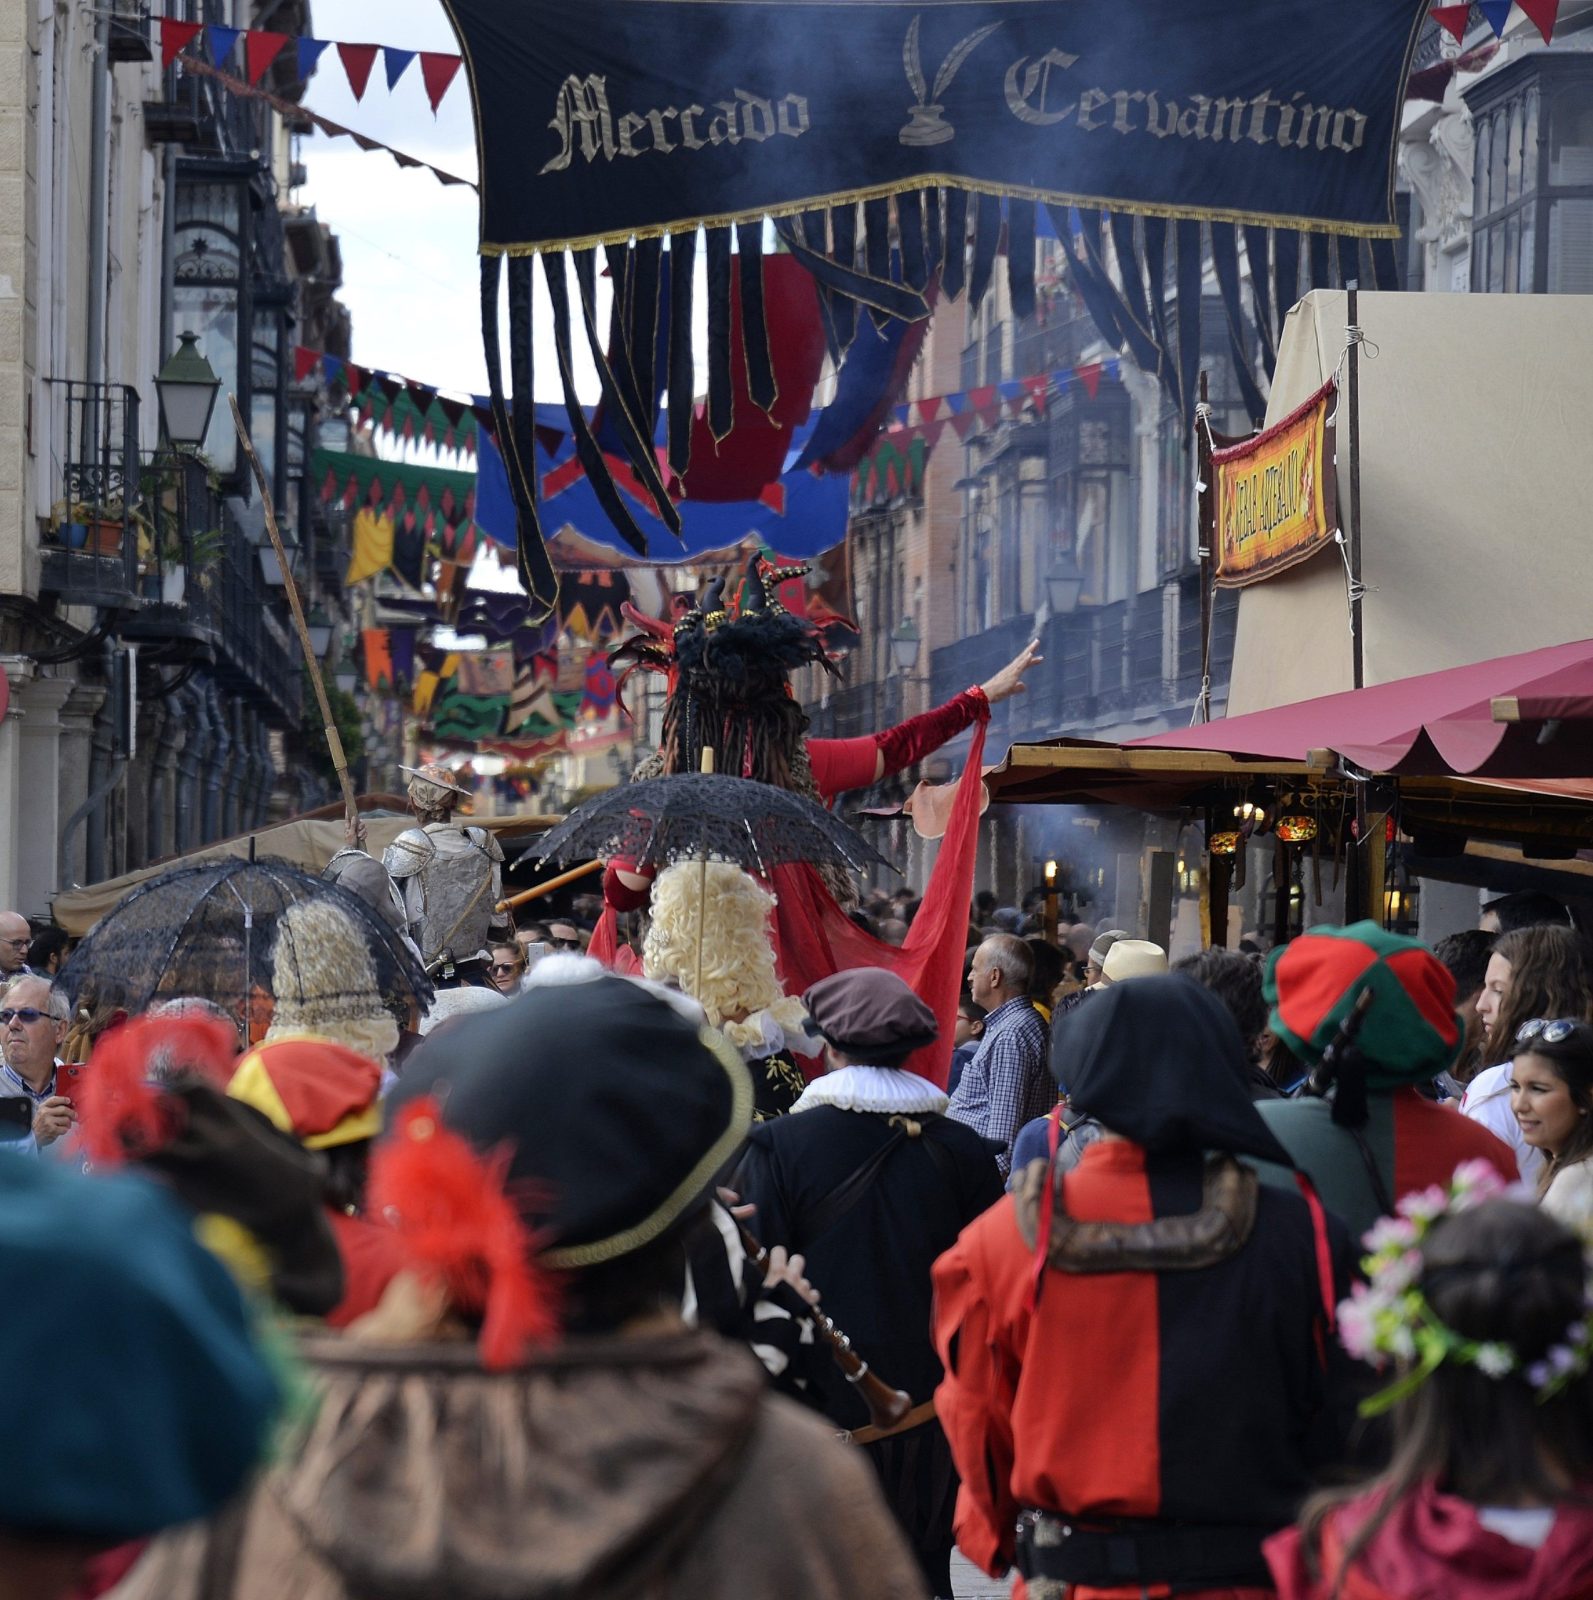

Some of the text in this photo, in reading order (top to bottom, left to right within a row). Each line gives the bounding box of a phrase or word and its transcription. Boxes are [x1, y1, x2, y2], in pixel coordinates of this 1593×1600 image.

[537, 47, 1368, 175] Mercado Cervantino
[1235, 449, 1298, 551] KEBAB ARTESANO
